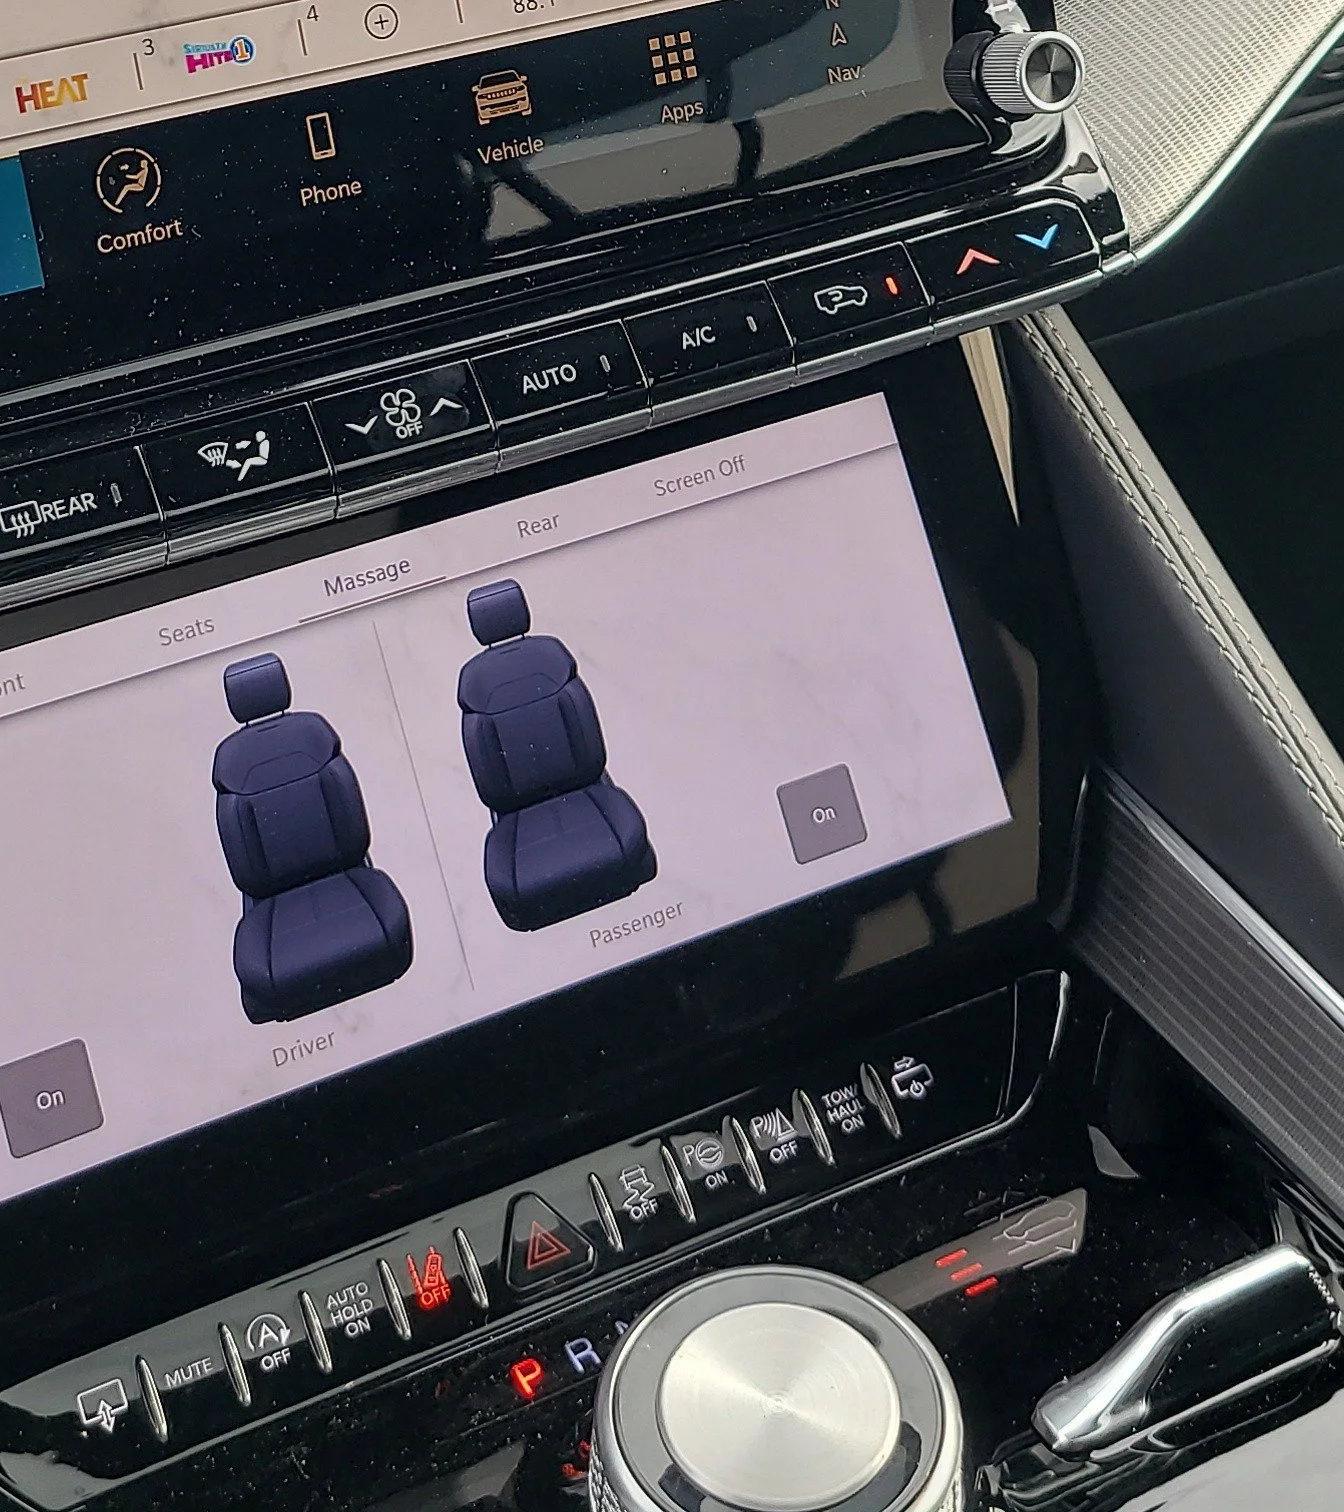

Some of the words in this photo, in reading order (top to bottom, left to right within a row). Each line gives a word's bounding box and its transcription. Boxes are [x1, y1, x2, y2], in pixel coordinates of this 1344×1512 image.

[306, 5, 319, 22] 4
[142, 38, 155, 57] 3
[827, 65, 861, 85] Nav
[15, 72, 89, 114] HEAT
[660, 99, 705, 125] Apps
[477, 136, 545, 166] Vehicle
[299, 177, 362, 207] Phone
[96, 218, 184, 255] Comfort
[680, 326, 716, 351] A/C
[521, 363, 578, 395] AUTO
[395, 420, 423, 439] OFF
[653, 465, 715, 497] Screen
[718, 454, 747, 480] Off
[41, 490, 98, 524] REAR
[516, 512, 560, 539] Rear
[323, 555, 412, 598] Massage
[158, 615, 216, 648] Seats
[812, 807, 836, 824] On
[589, 899, 685, 948] Passenger
[271, 1029, 337, 1068] Driver
[36, 1087, 66, 1110] On
[826, 1098, 866, 1124] HAUL
[841, 1114, 866, 1134] ON
[769, 1140, 799, 1164] OFF
[705, 1170, 728, 1189] ON
[630, 1198, 658, 1221] OFF
[326, 1281, 369, 1310] AUTO
[420, 1286, 452, 1308] OFF
[330, 1299, 374, 1327] HOLD
[345, 1317, 371, 1338] ON
[164, 1357, 212, 1388] MUTE
[260, 1348, 292, 1373] OFF
[510, 1358, 544, 1399] P
[564, 1337, 601, 1374] R
